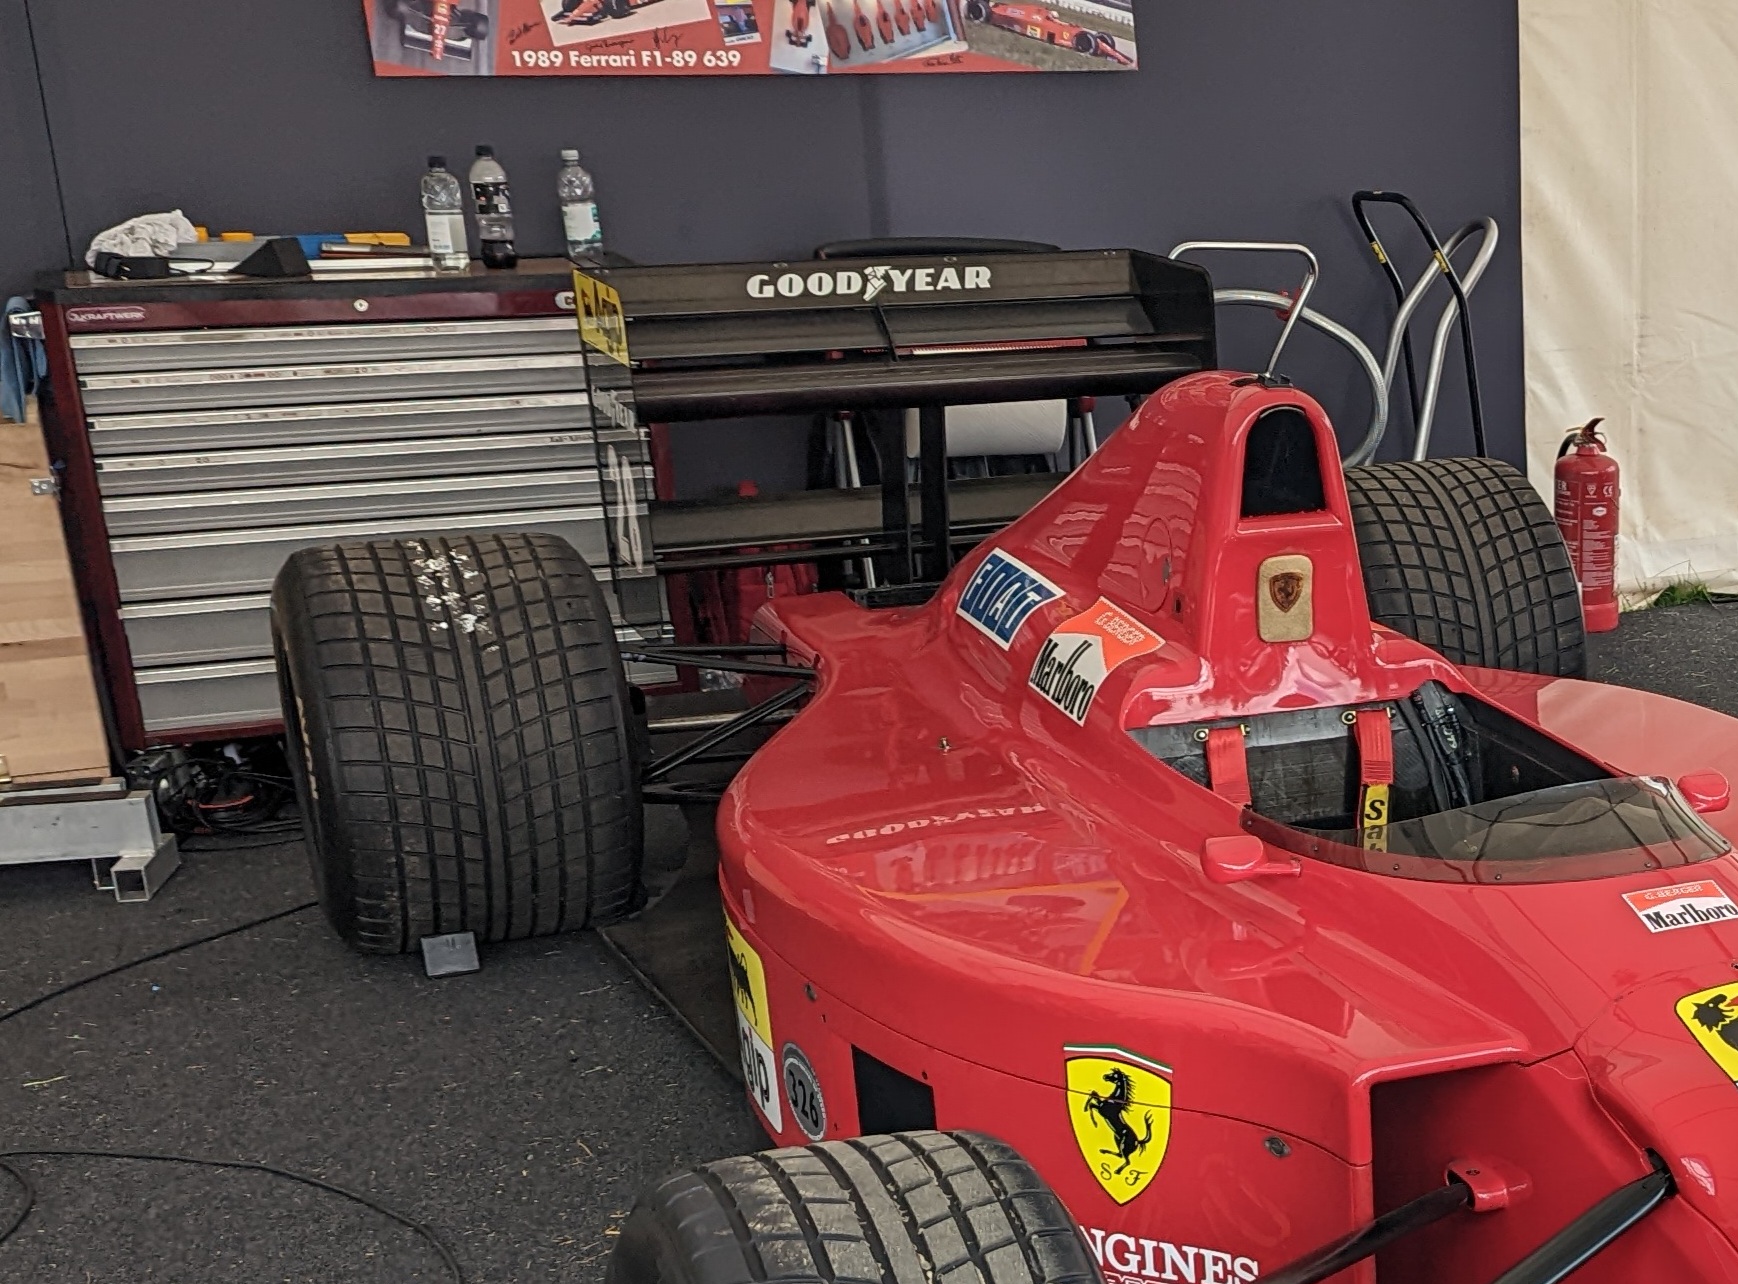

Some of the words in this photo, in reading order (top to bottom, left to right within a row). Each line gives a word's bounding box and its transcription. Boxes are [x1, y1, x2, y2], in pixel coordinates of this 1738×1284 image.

[511, 50, 563, 67] 1989
[569, 50, 636, 67] Ferrari
[642, 50, 697, 67] F1-89
[702, 51, 741, 67] 639
[962, 556, 1052, 640] FIAT
[1031, 638, 1096, 722] Marlboro
[788, 1068, 819, 1129] 326
